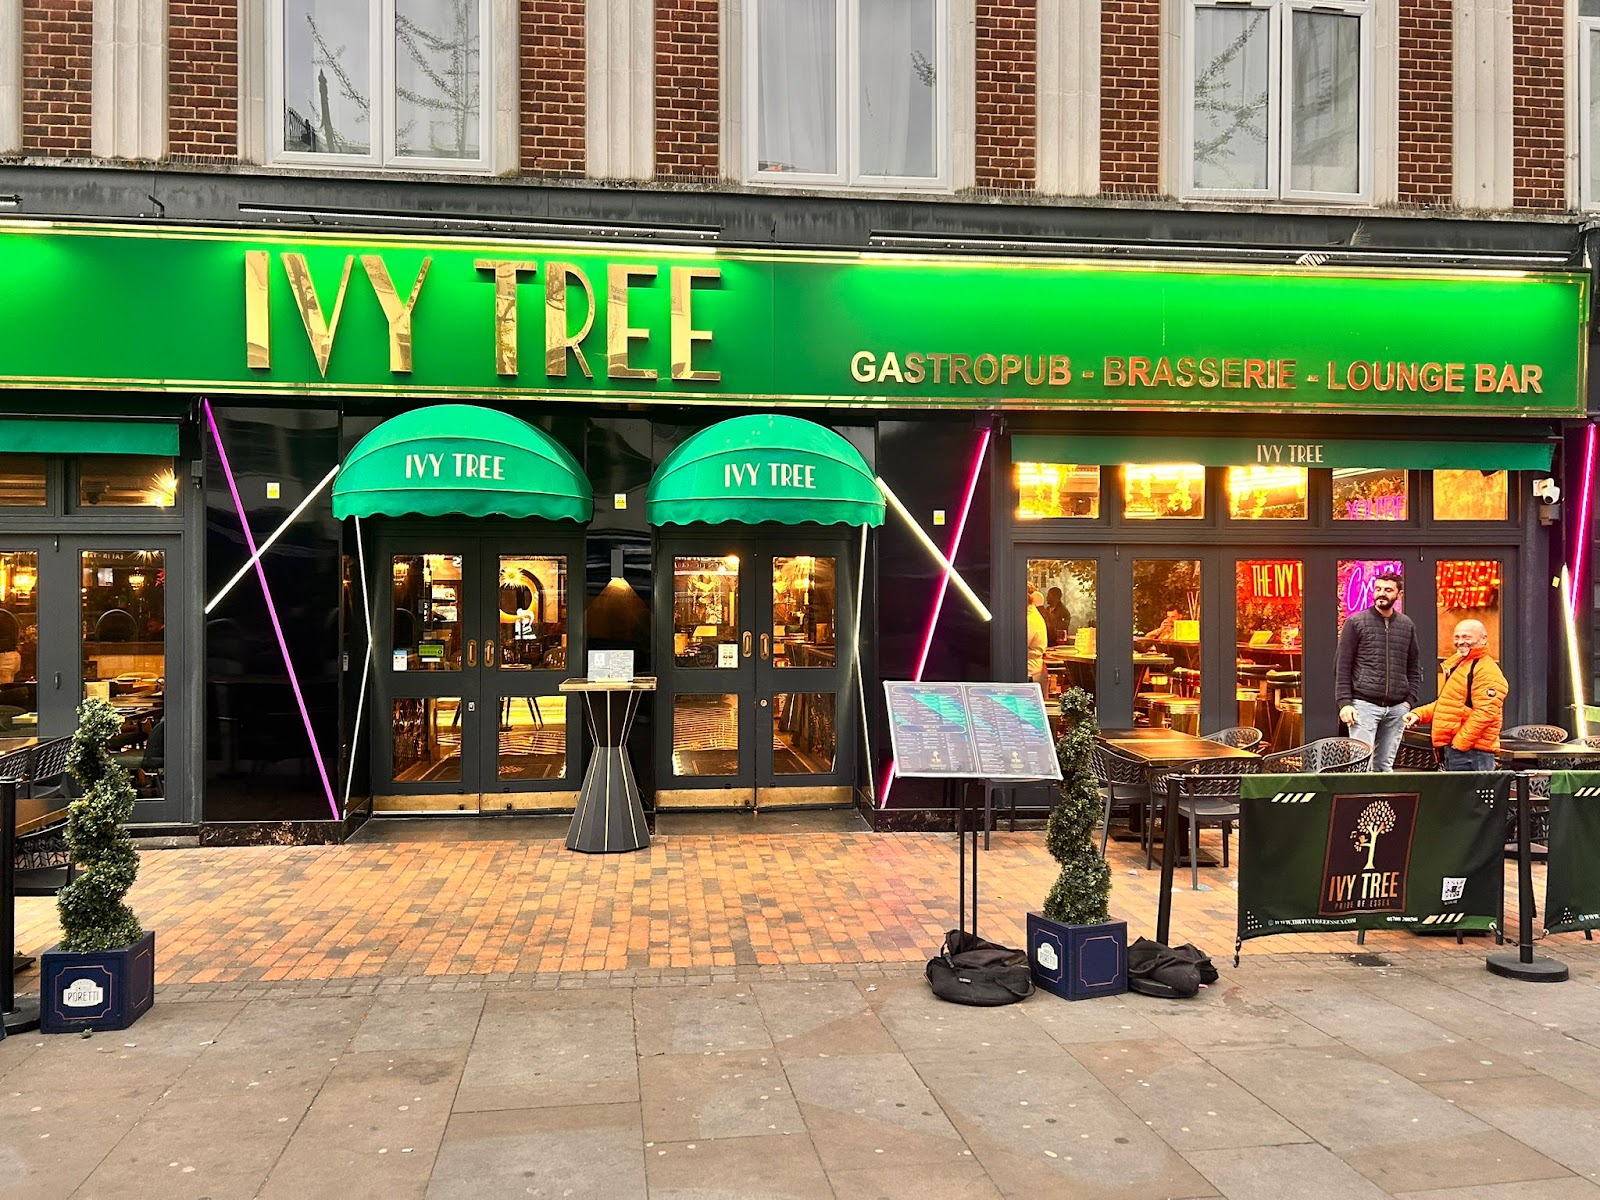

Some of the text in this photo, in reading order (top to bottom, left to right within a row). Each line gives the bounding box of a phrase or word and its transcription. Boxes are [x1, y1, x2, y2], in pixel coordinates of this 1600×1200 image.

[244, 250, 722, 383] IVY TREE
[850, 350, 1072, 387] GASTROPUB
[1103, 355, 1298, 390] BRASSERIE
[1327, 360, 1465, 392] LOUNGE
[1474, 363, 1543, 394] BAR
[405, 453, 506, 480] IVY TREE
[1257, 445, 1324, 463] IVY TREE
[724, 463, 817, 488] IVY TREE
[1251, 564, 1273, 597] THE
[1274, 563, 1294, 598] IVY
[1437, 560, 1501, 587] PEROL
[1328, 871, 1399, 902] IVY TREE
[1334, 899, 1390, 910] PRIDE OF ESSEX
[68, 991, 99, 1002] PORETTI
